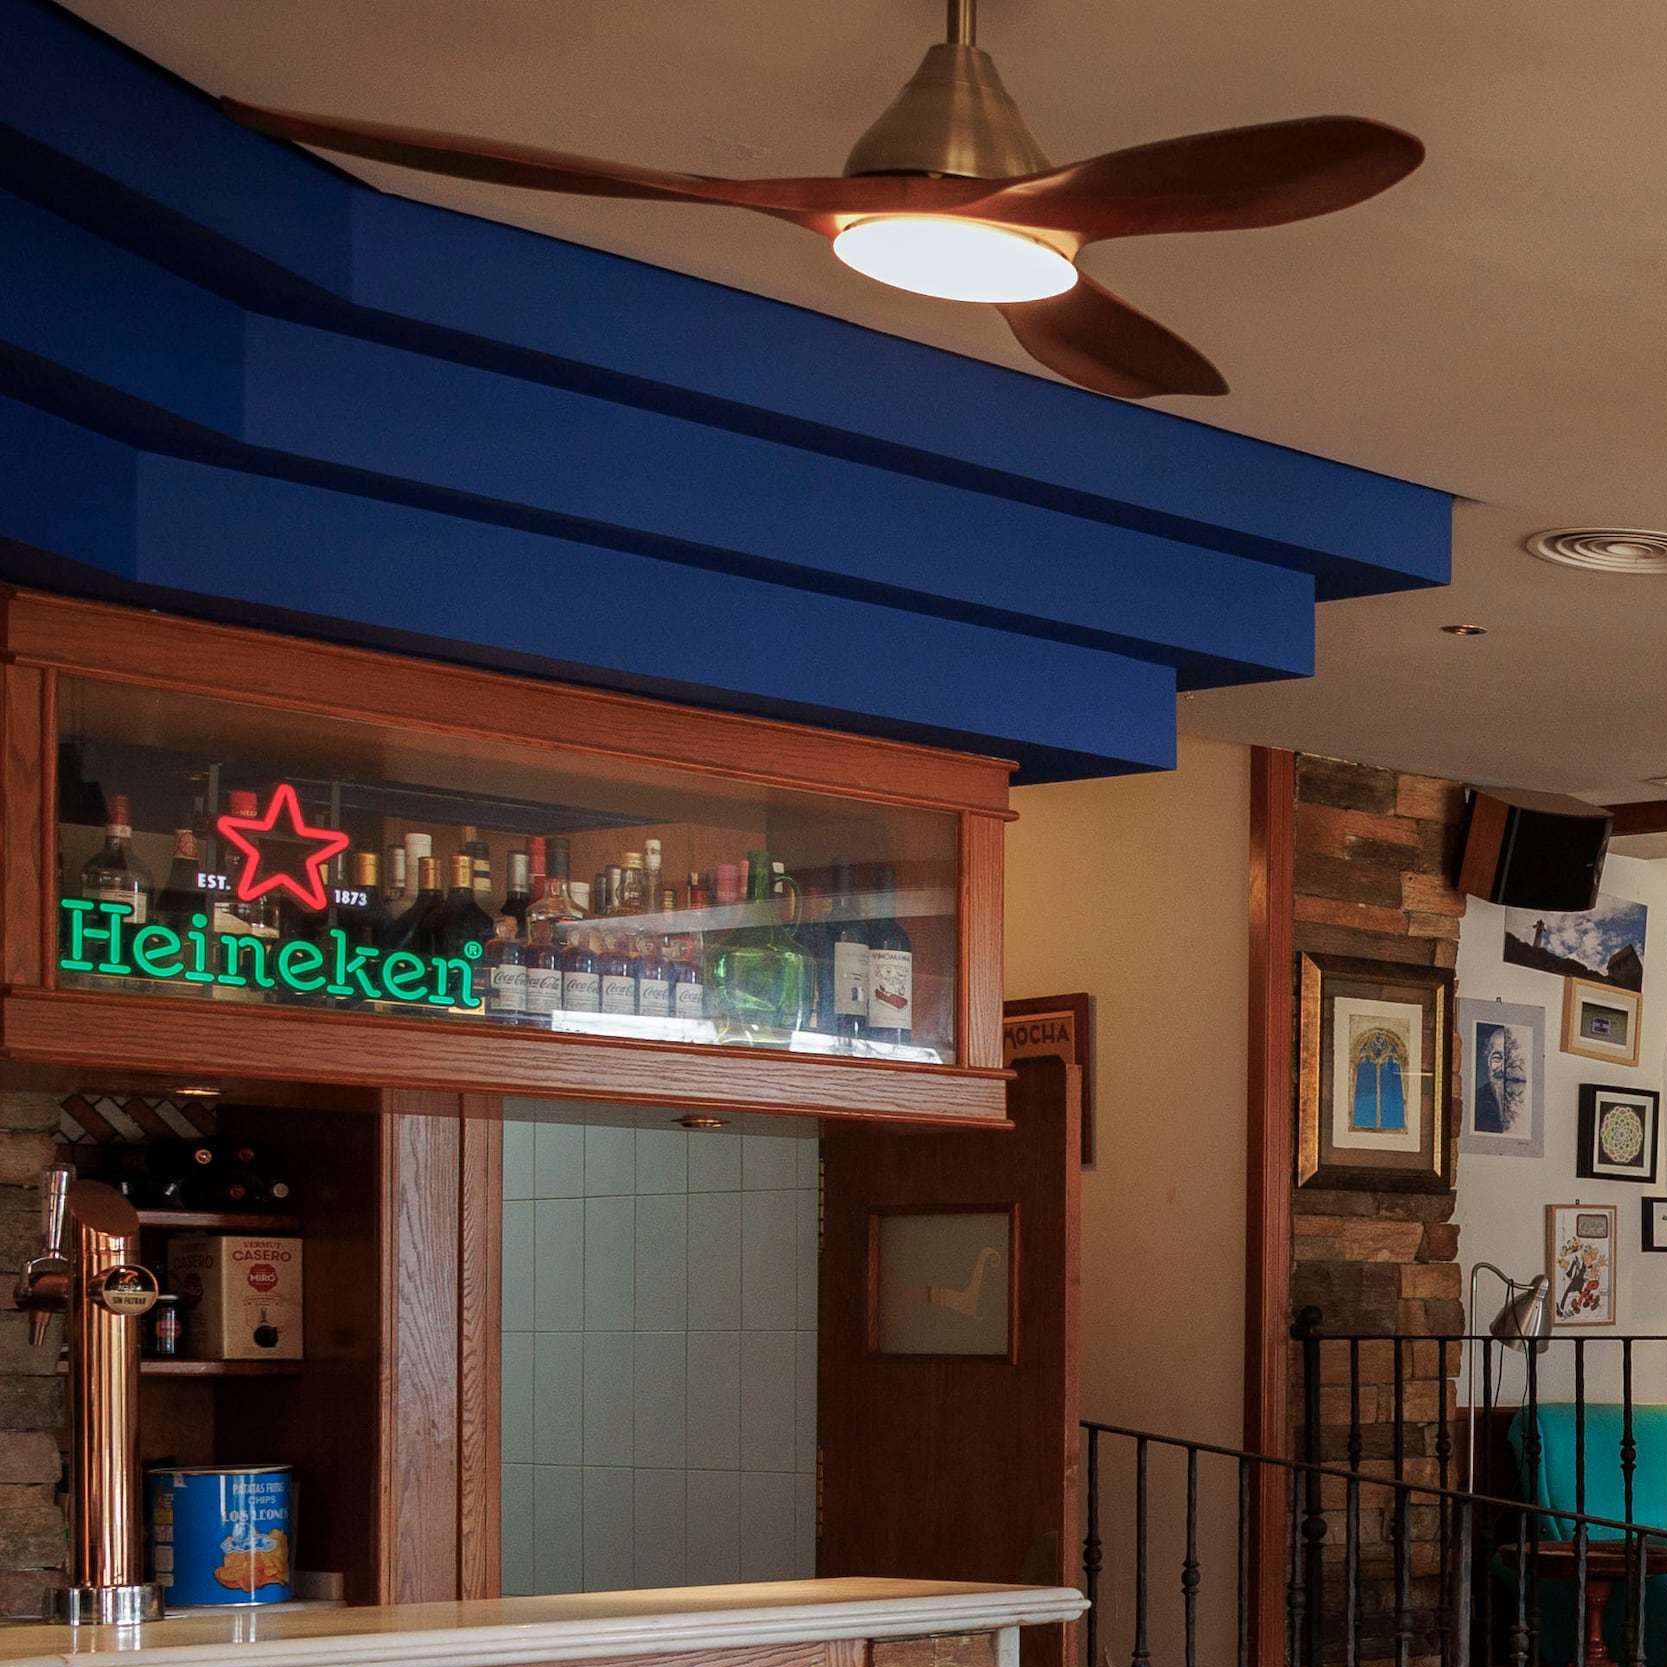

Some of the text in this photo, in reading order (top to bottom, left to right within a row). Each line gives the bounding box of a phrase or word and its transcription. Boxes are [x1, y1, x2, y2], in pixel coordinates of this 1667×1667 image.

[197, 873, 231, 890] EST.
[334, 889, 368, 906] 1873
[60, 898, 480, 1007] Heineken
[1003, 1022, 1070, 1050] MOCHA
[243, 1241, 281, 1249] VERMUT
[232, 1250, 291, 1262] CASERO
[233, 1483, 265, 1495] PATATAS
[248, 1495, 277, 1505] CHIPS
